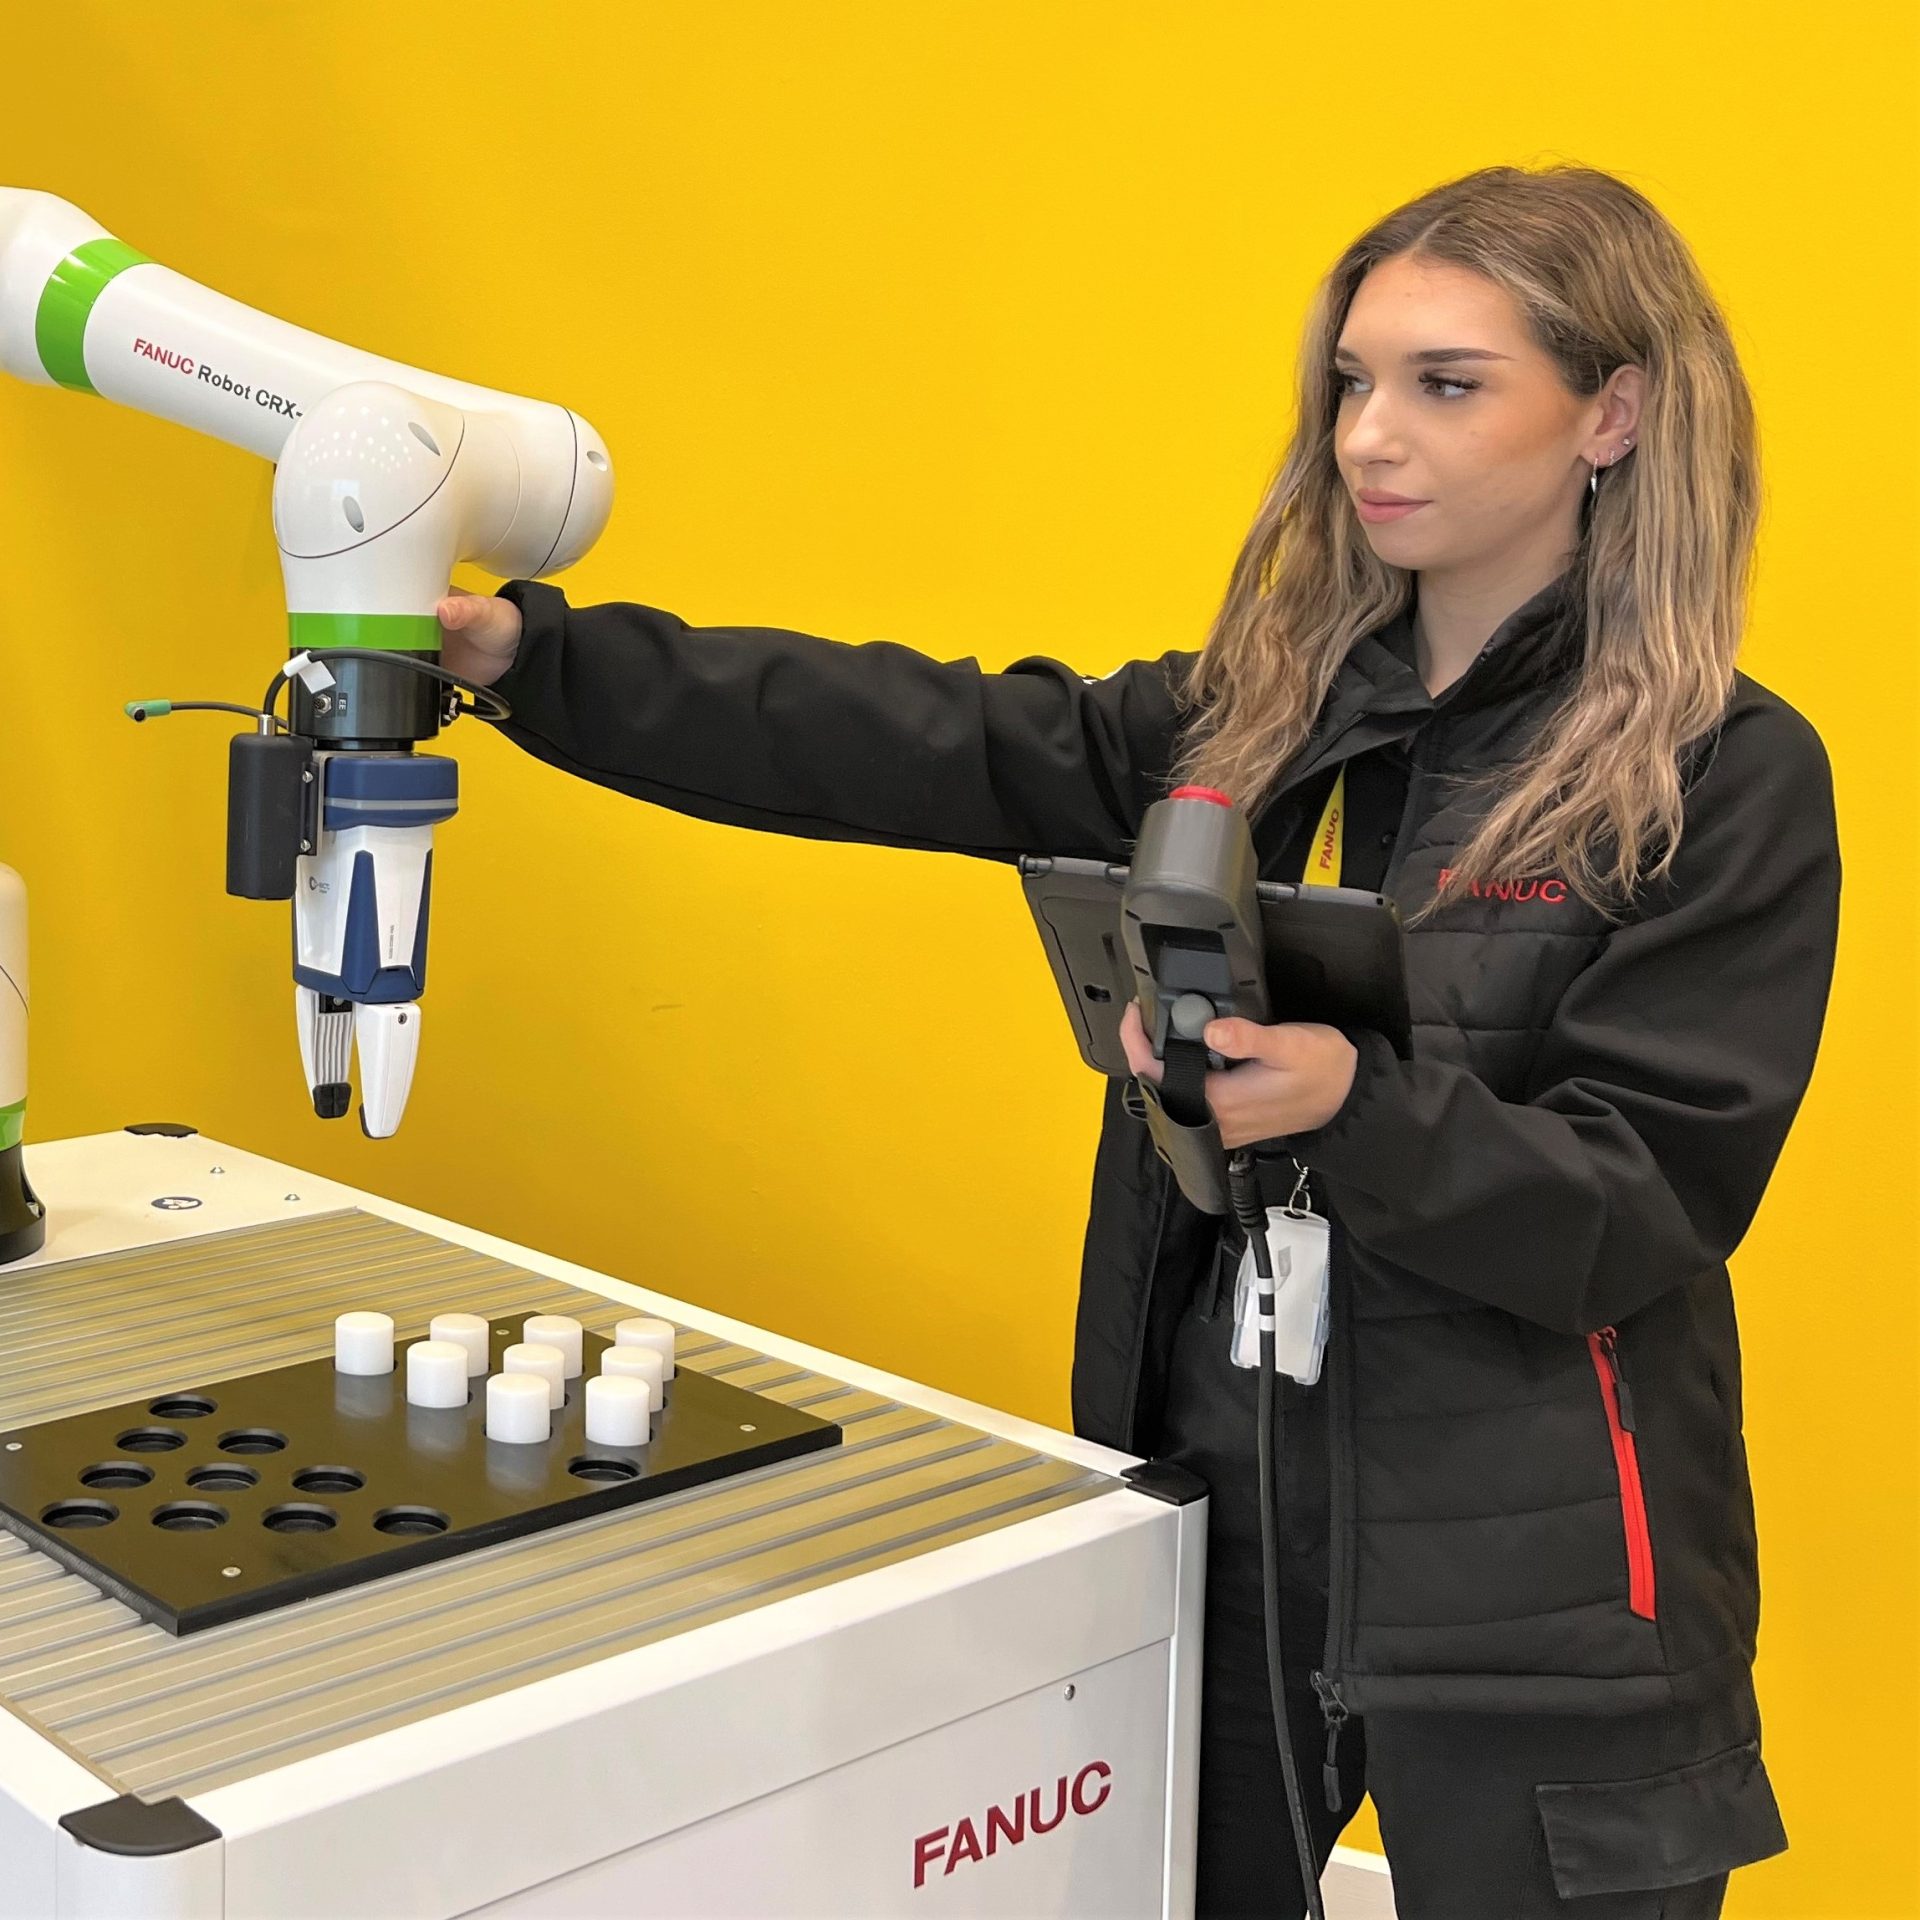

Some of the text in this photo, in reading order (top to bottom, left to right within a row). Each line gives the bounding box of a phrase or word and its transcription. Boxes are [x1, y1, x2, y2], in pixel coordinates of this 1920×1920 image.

[133, 338, 303, 419] FANUC Robot CRX-
[1319, 808, 1339, 869] FANUC
[914, 1760, 1112, 1888] FANUC
